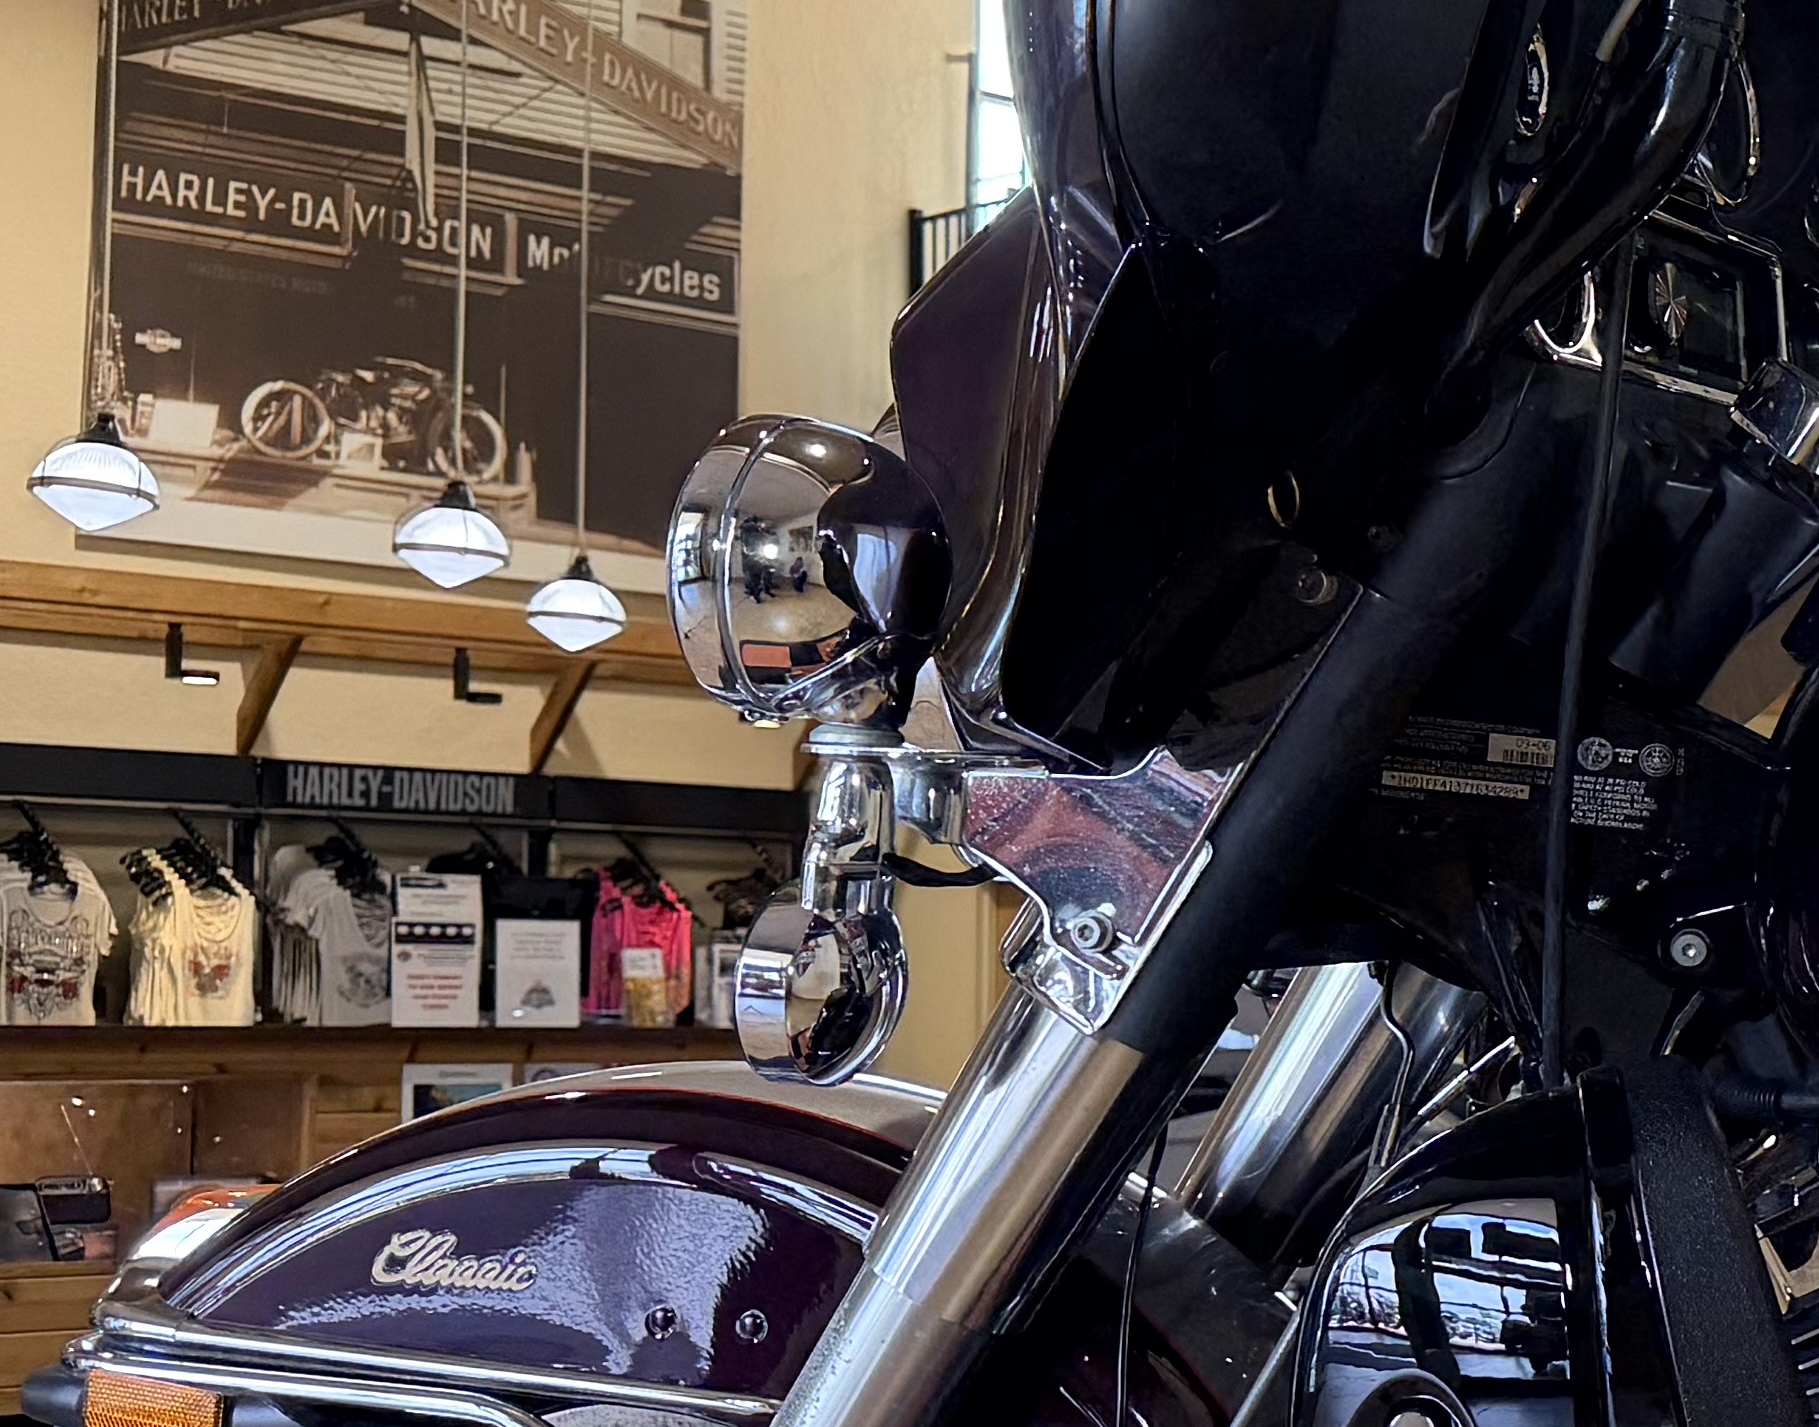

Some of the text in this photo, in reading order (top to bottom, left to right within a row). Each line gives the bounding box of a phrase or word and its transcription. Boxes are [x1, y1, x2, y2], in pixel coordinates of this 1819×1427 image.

[119, 162, 493, 261] HARLEY-DAVIDSON
[286, 763, 515, 815] HARLEY-DAVIDSON
[371, 1228, 540, 1292] Classic
